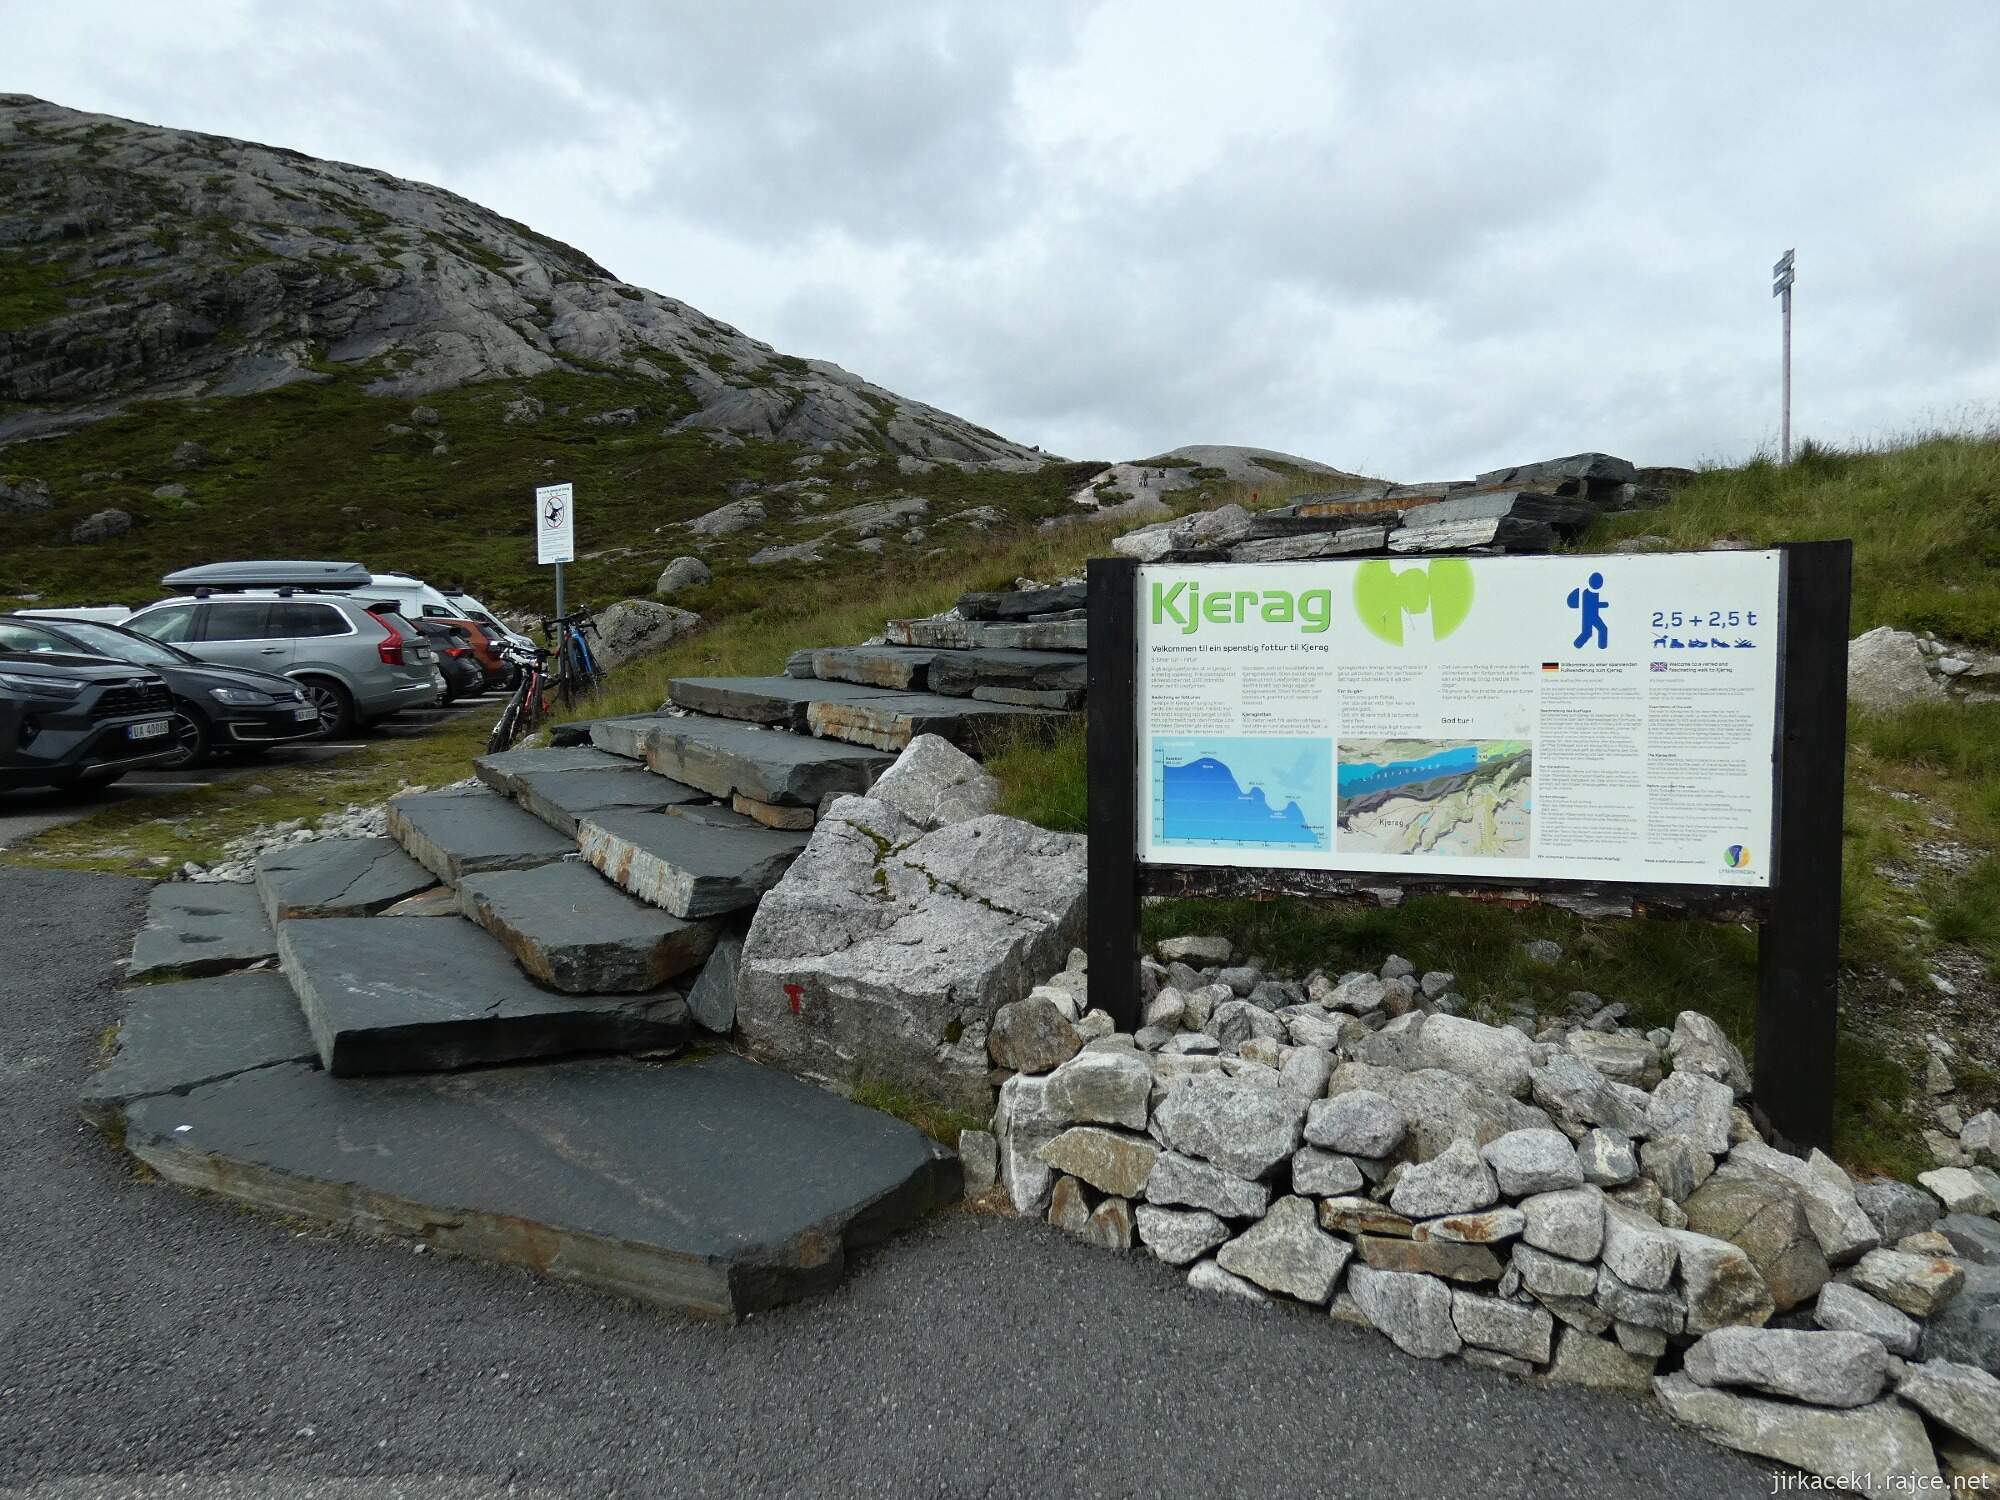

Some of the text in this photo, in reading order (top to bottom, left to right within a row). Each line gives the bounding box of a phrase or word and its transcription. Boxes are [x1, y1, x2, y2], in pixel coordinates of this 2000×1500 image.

[1152, 581, 1332, 635] Kjerag
[1652, 610, 1757, 629] 2,5 + 2,5 t
[1223, 644, 1259, 654] spenstig
[1301, 643, 1329, 653] Kjerag
